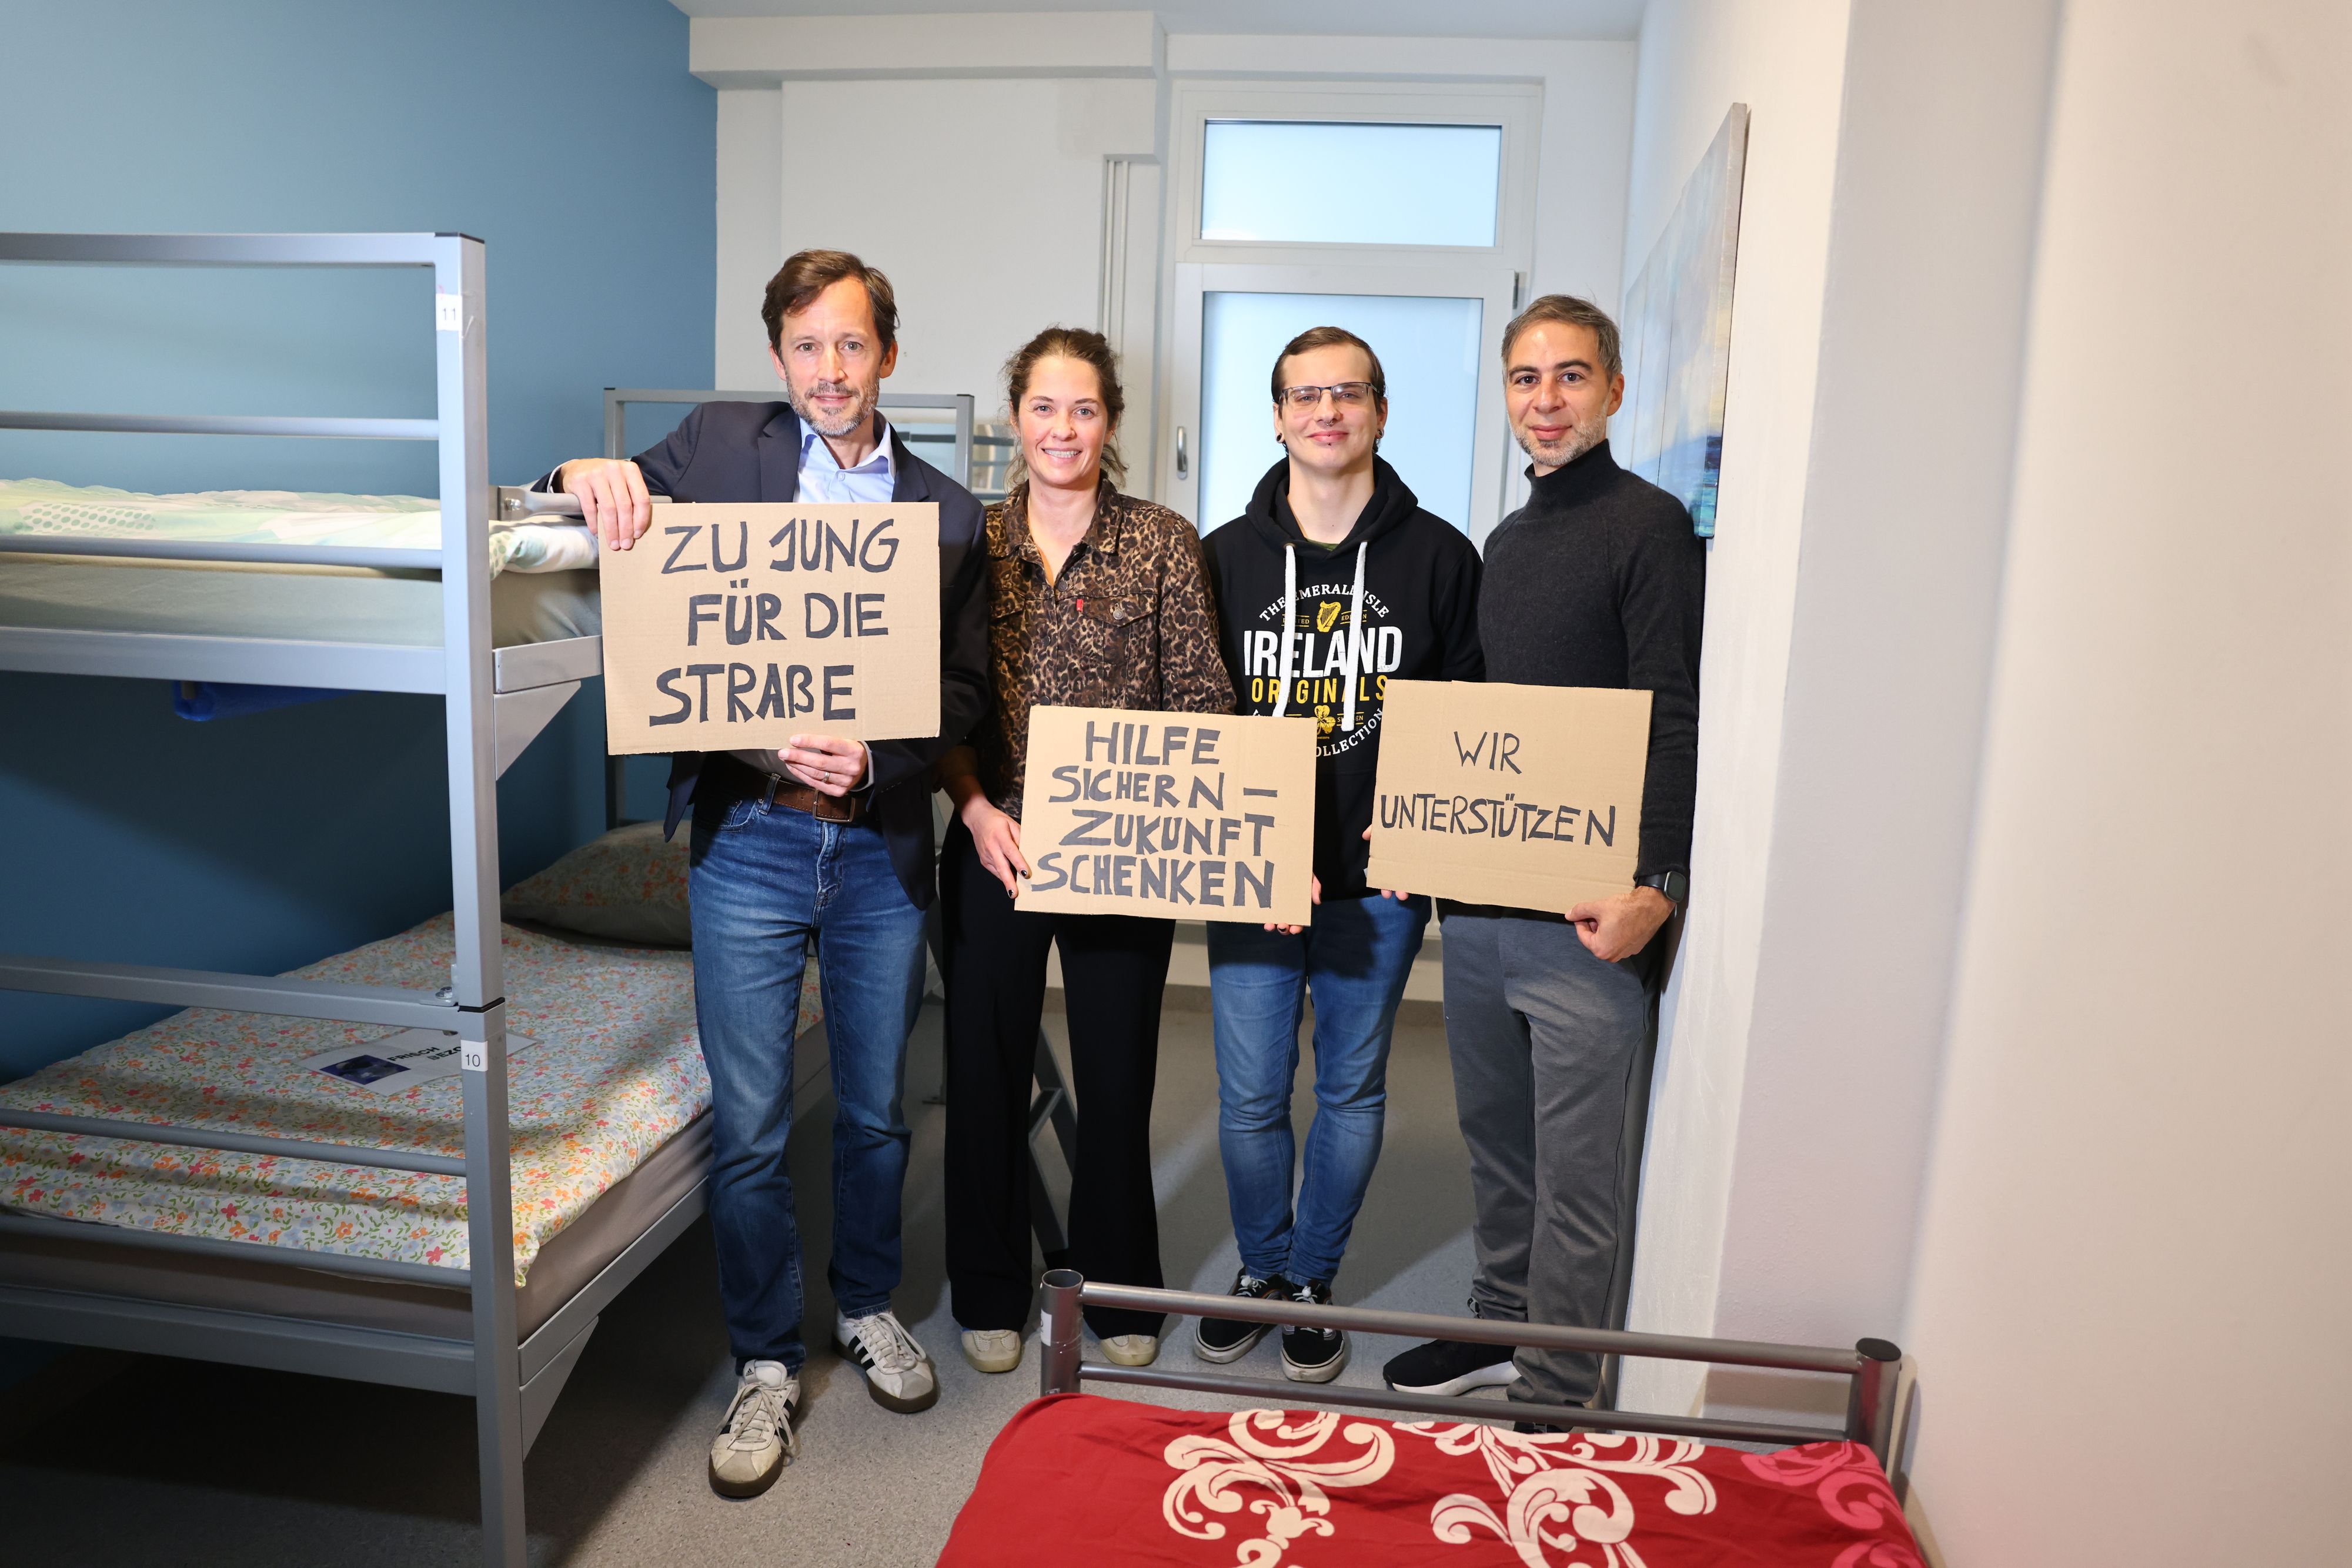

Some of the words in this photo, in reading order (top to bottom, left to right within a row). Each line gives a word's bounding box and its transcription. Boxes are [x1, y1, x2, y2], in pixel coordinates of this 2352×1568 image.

[442, 307, 456, 320] 11
[661, 521, 748, 574] ZU
[769, 518, 900, 573] JUNG
[687, 578, 787, 646] FÜR
[804, 592, 888, 638] DIE
[1259, 596, 1285, 621] THE
[1295, 583, 1354, 601] MERAL
[649, 663, 856, 727] STRAßE
[1251, 675, 1388, 704] ORGINLS
[1085, 721, 1221, 765] HILFE
[1316, 708, 1383, 757] OLLECTION
[1454, 731, 1522, 774] WIR
[1048, 765, 1225, 811] SICHERN
[1058, 809, 1275, 857] ZUKUNFT
[1381, 793, 1616, 847] UNTERSTÜTZEN
[1030, 852, 1274, 908] SCHENKEN
[465, 1054, 480, 1067] 10
